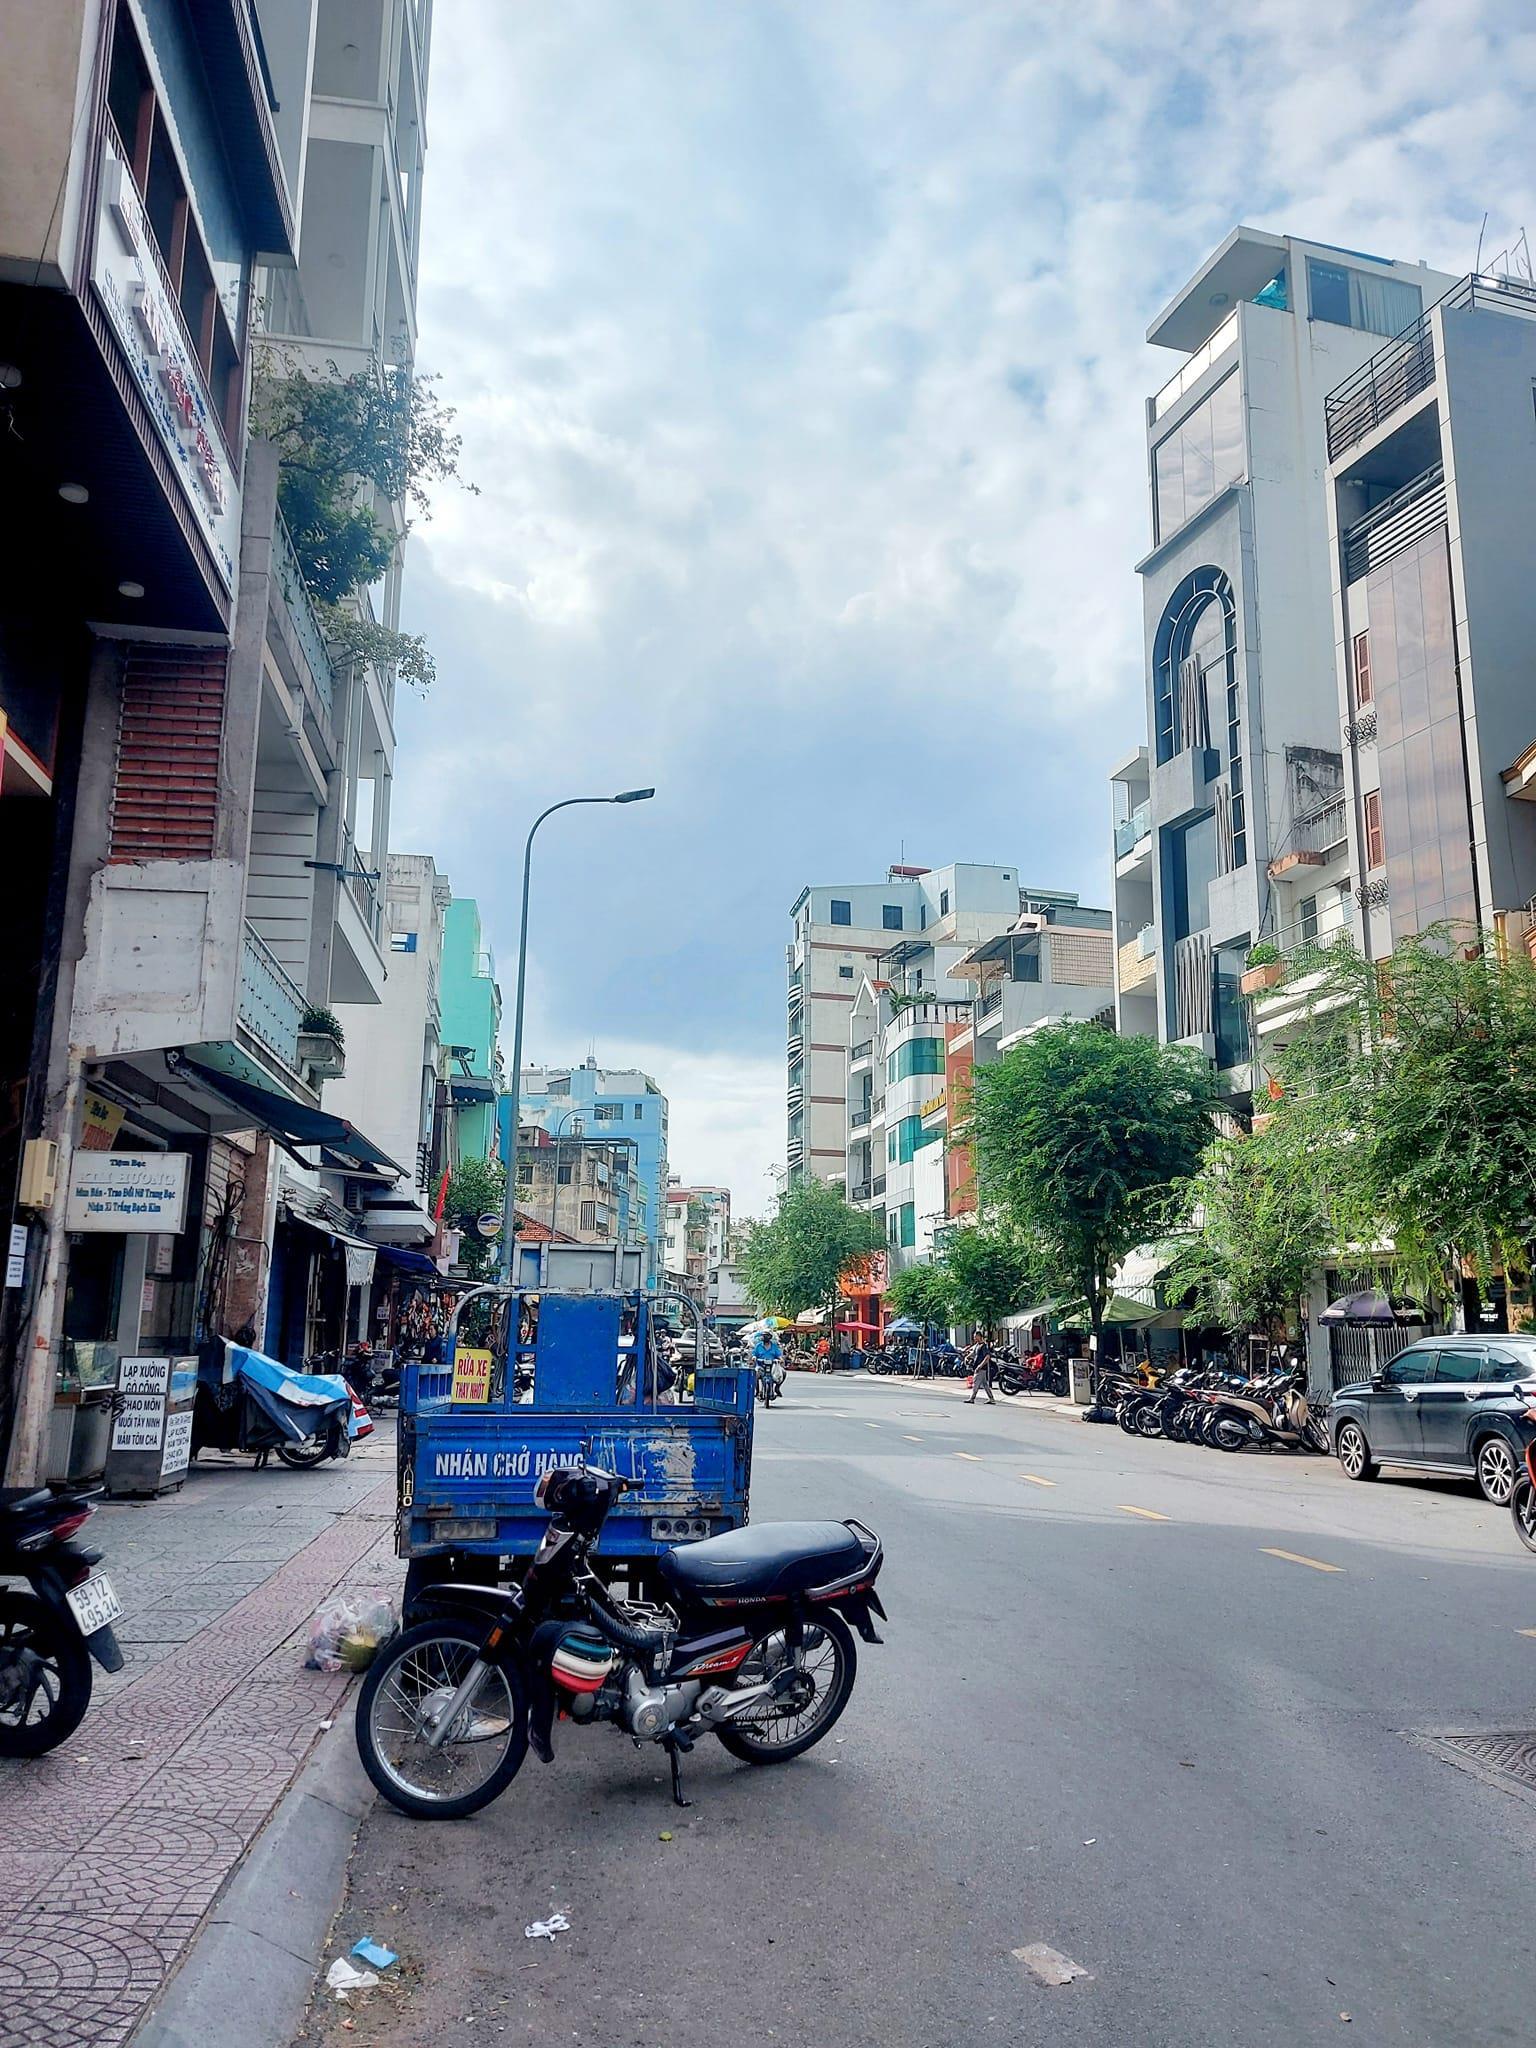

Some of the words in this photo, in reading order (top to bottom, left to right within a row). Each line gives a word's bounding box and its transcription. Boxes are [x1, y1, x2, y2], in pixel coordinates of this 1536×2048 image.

[123, 1365, 138, 1380] LẠP
[457, 1352, 475, 1377] RỬA
[476, 1359, 488, 1377] XE
[455, 1381, 470, 1400] THAY
[493, 1444, 531, 1477] CHỞ
[738, 1596, 767, 1604] HONDA
